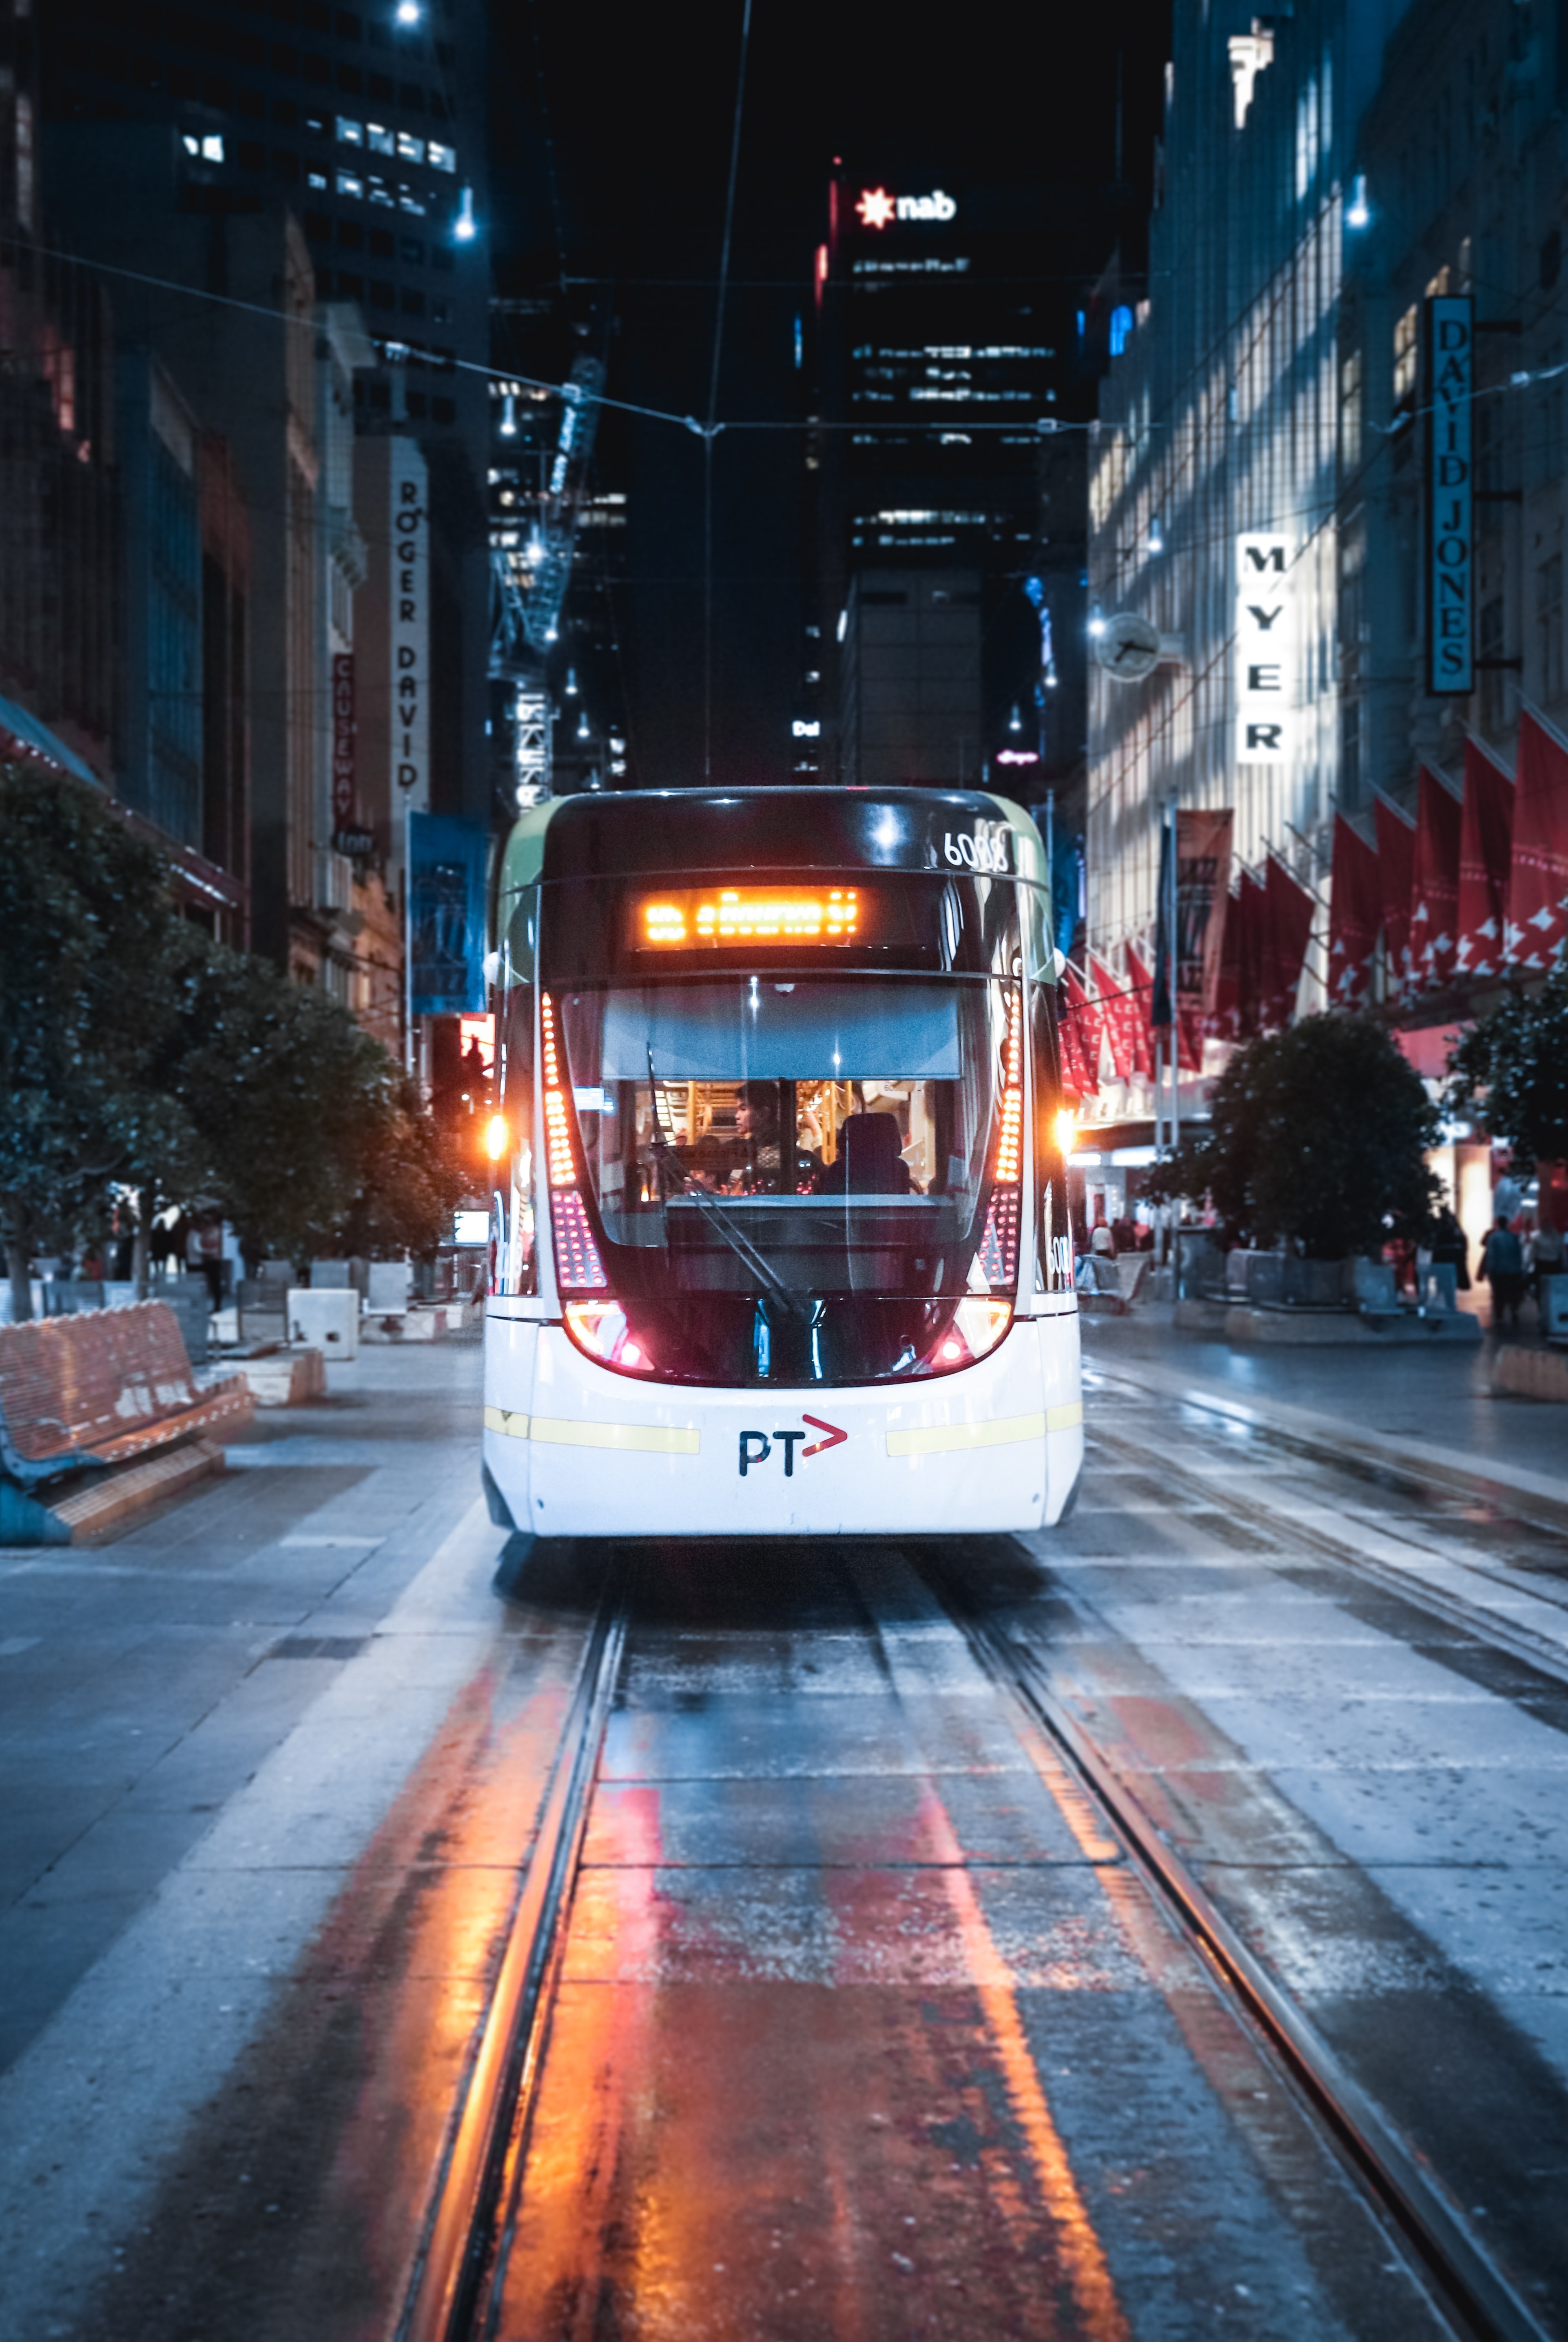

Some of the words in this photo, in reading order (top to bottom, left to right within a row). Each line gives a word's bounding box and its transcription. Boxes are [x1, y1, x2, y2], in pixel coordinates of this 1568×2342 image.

[897, 190, 956, 221] nab
[1438, 320, 1467, 487] DAVID
[396, 482, 418, 622] ROGER
[1437, 501, 1467, 674] JONES
[398, 647, 417, 787] DAVID
[1245, 546, 1286, 750] MYER
[335, 659, 353, 815] CAUSEWAY
